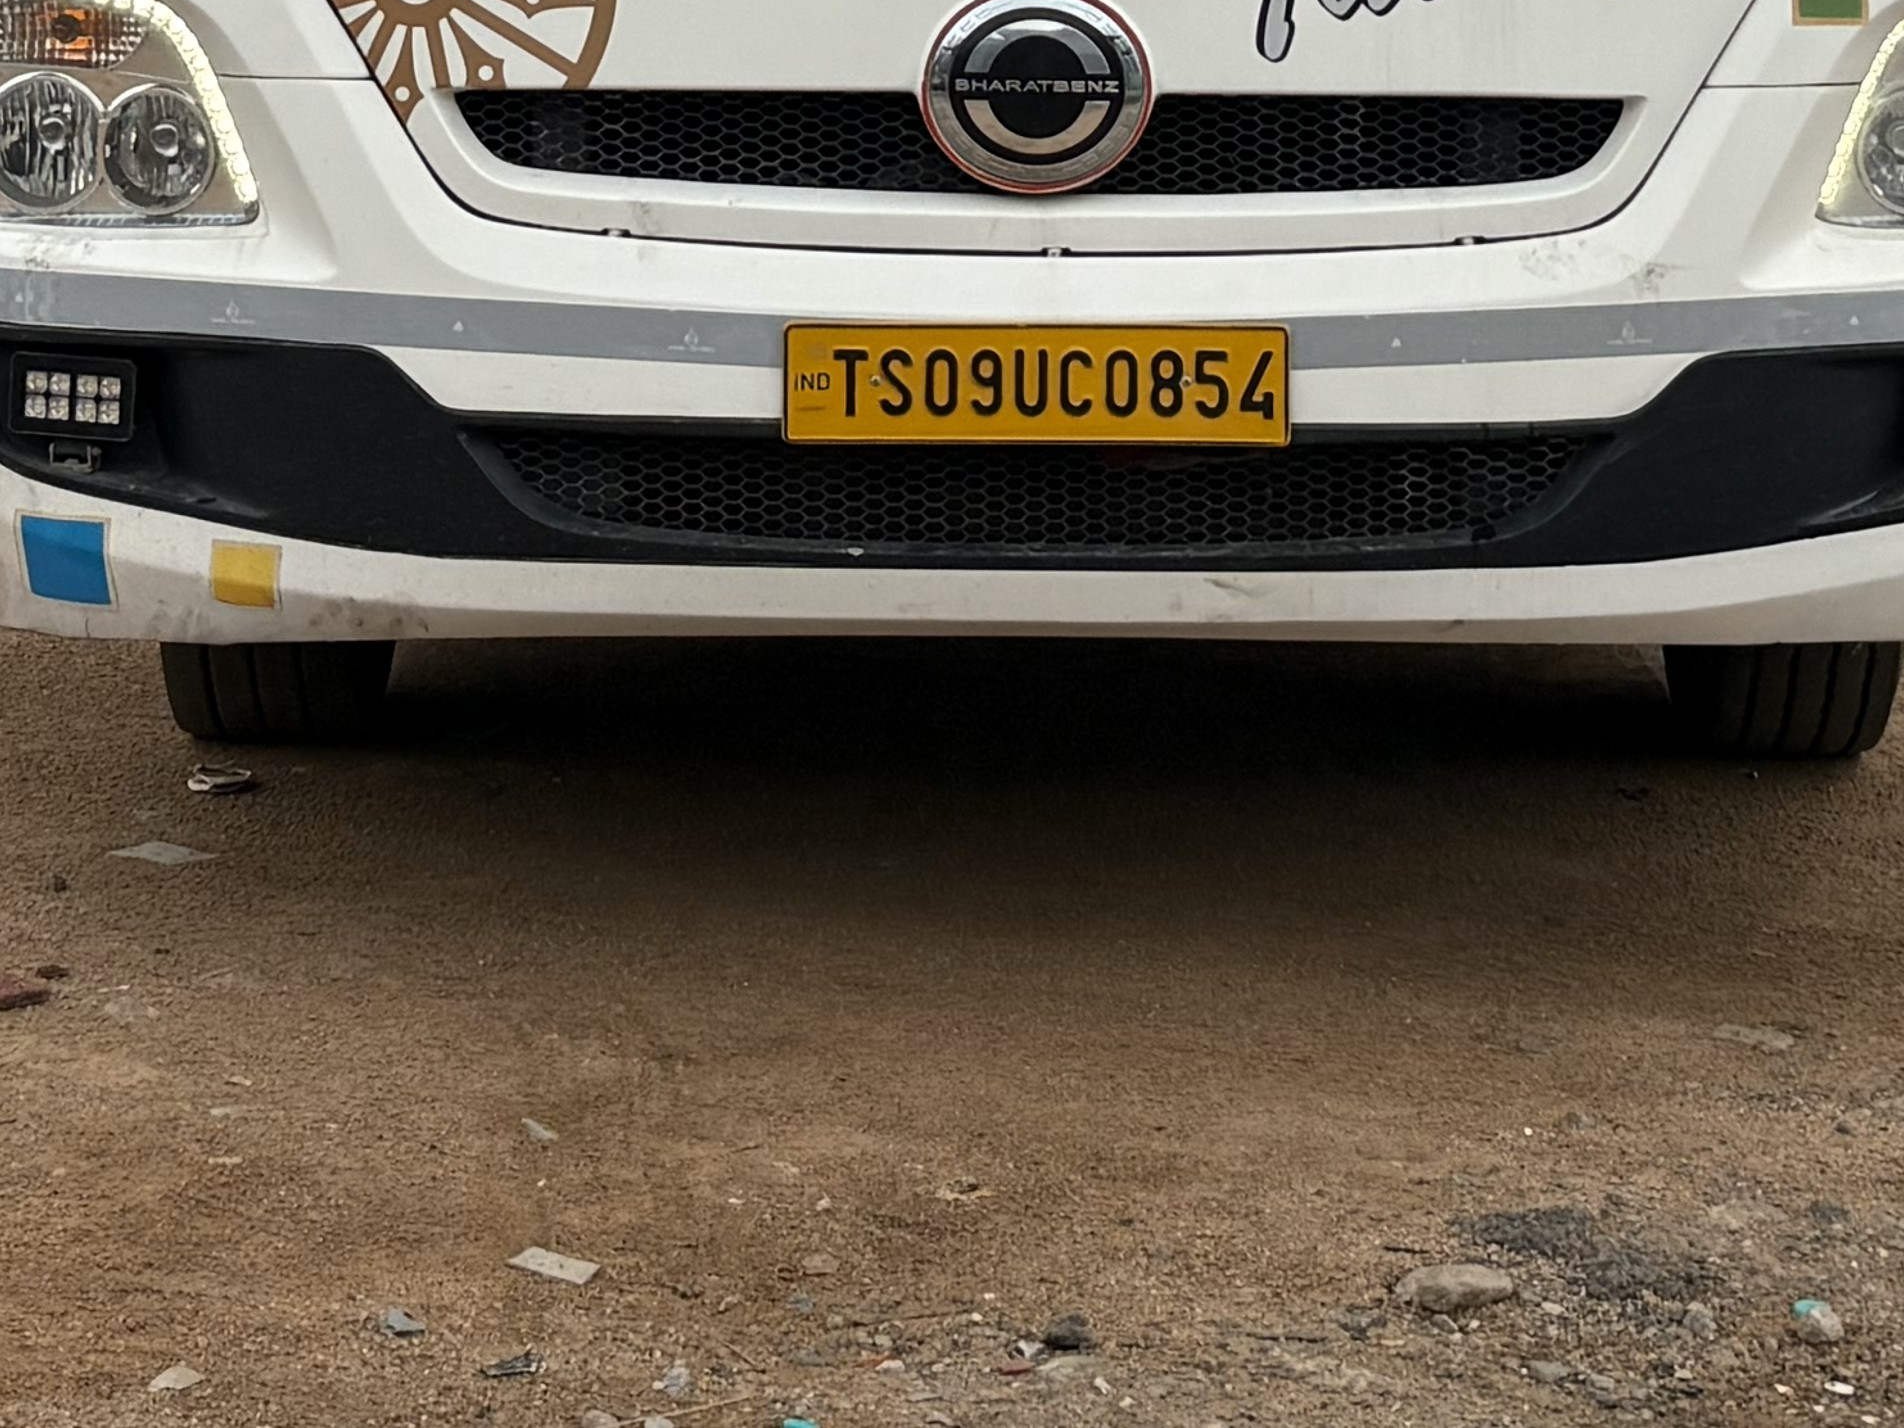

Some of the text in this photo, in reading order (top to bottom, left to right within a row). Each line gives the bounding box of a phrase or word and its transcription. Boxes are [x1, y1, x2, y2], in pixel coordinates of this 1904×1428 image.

[954, 78, 1120, 93] BHARATBENZ
[794, 349, 1275, 421] IND TS09UC0854
